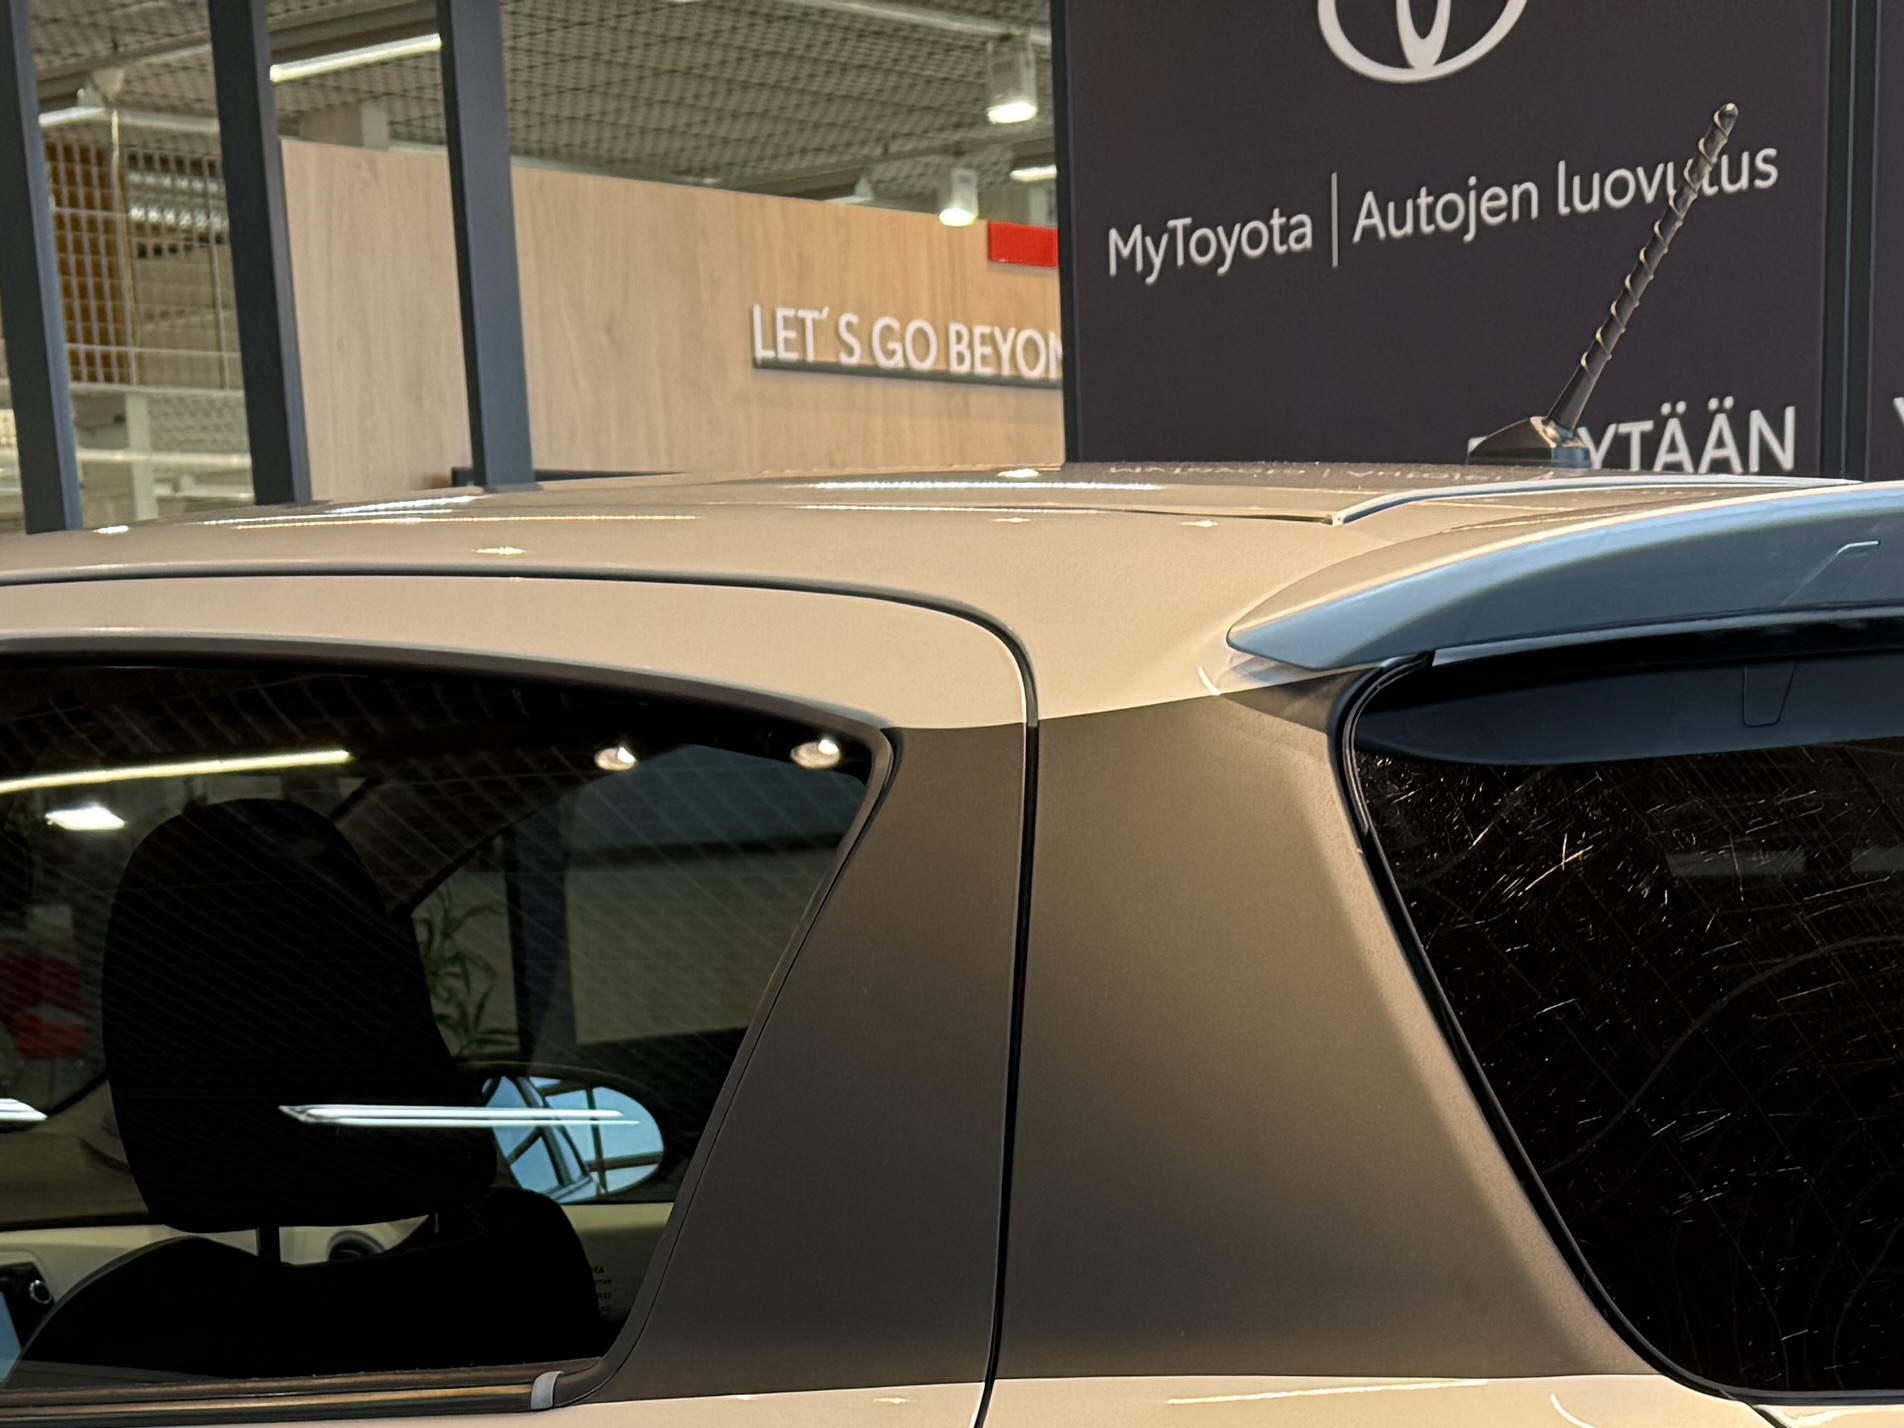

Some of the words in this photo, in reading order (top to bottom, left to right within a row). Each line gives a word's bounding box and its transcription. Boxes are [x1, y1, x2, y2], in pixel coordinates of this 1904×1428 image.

[1108, 210, 1313, 285] MyToyota
[1353, 175, 1540, 243] Autojen
[872, 315, 938, 371] GO
